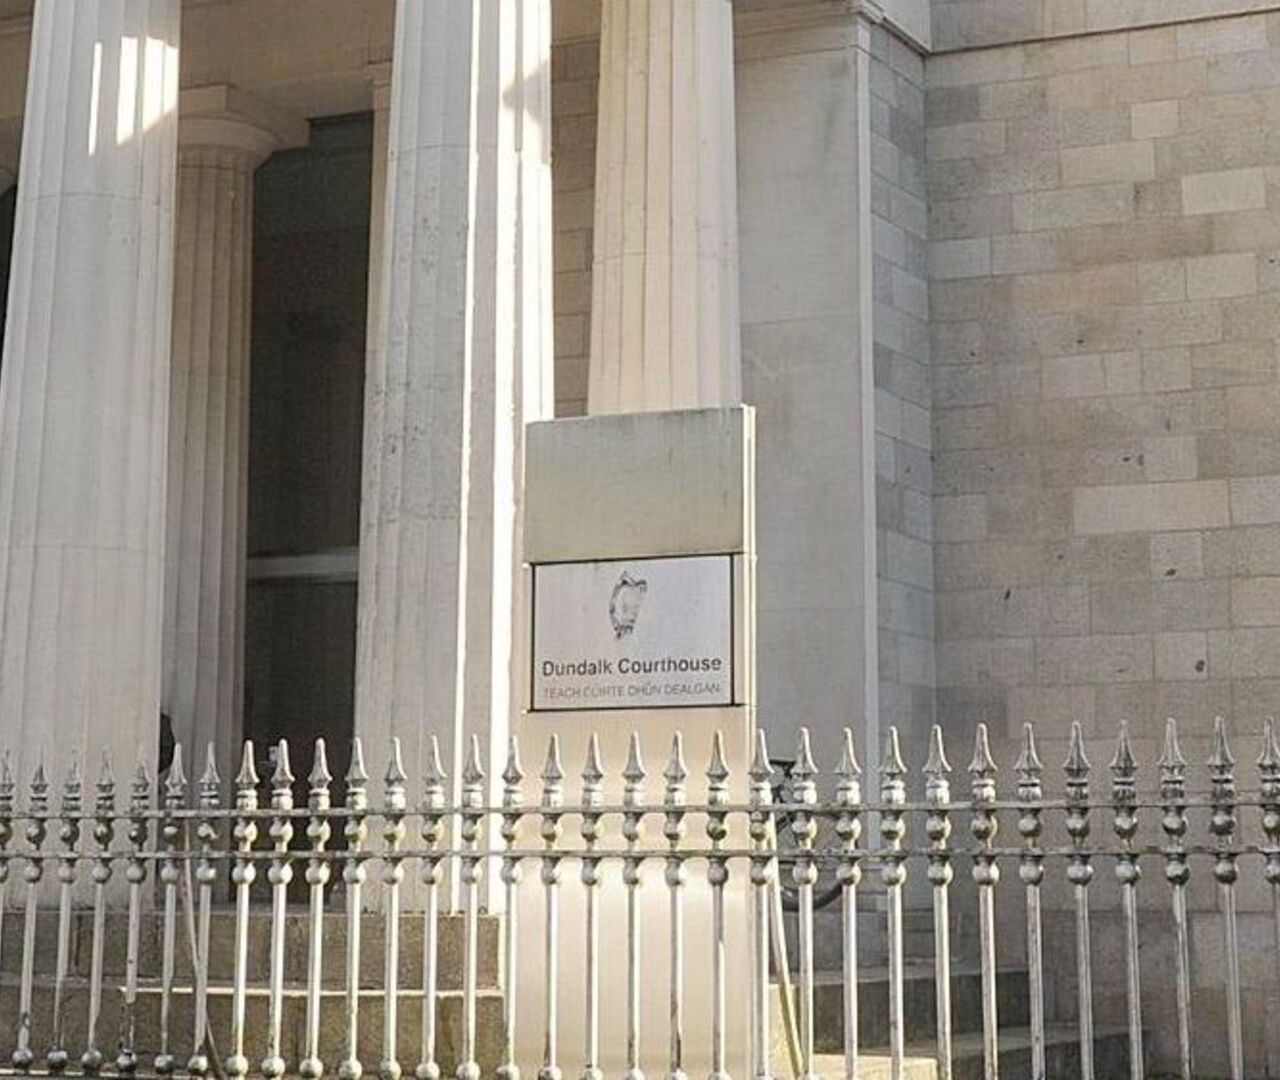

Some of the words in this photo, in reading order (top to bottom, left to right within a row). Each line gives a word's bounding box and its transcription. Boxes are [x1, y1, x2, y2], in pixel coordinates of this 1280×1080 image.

[542, 659, 613, 677] Dundalk
[617, 656, 723, 675] Courthouse
[544, 686, 581, 699] TEACH
[663, 682, 721, 696] DEALGAN
